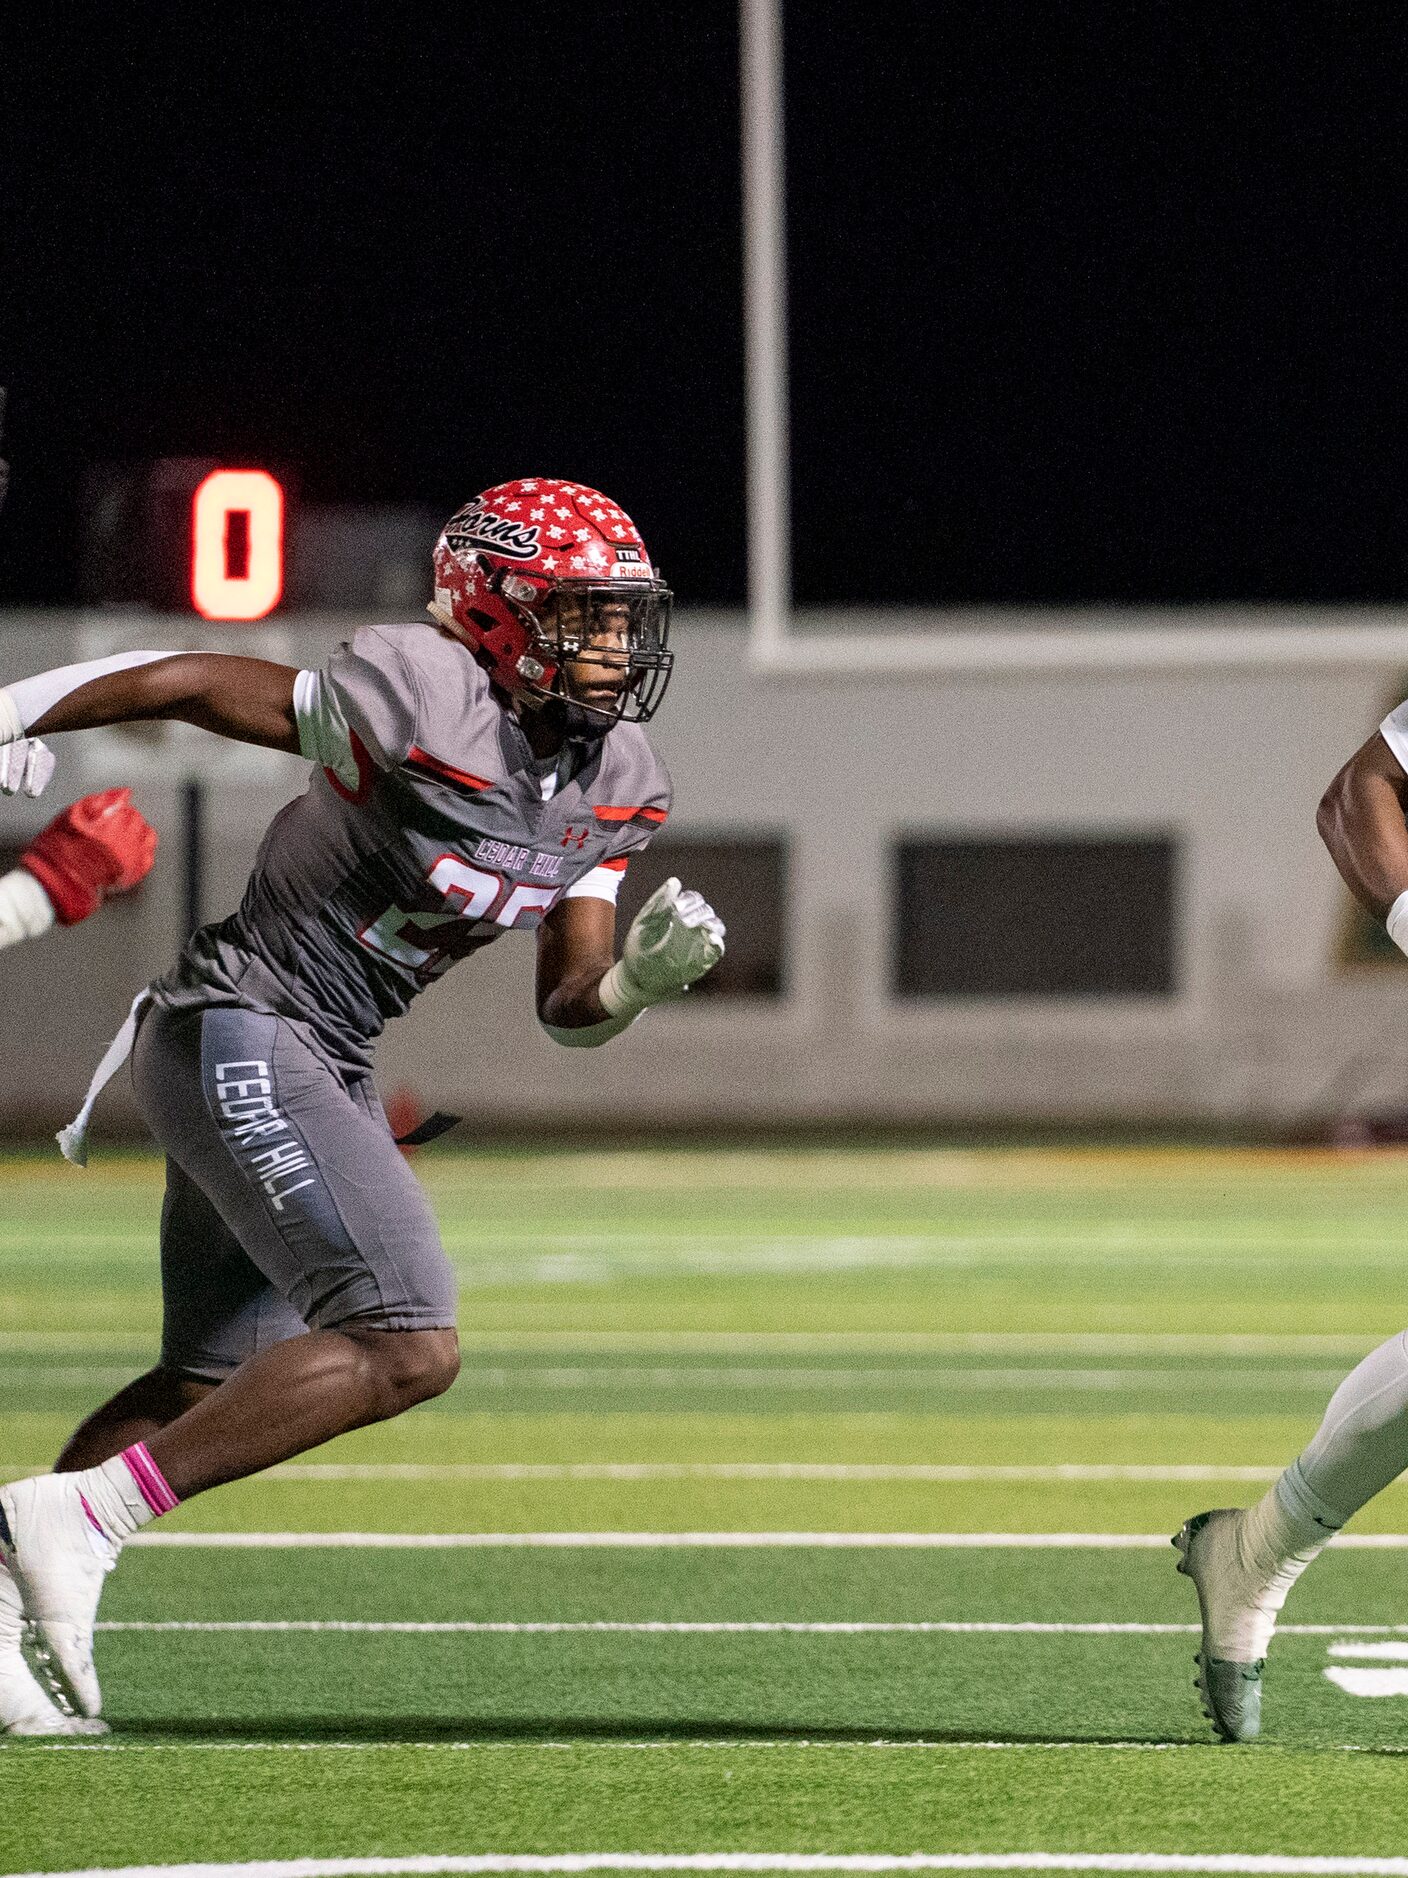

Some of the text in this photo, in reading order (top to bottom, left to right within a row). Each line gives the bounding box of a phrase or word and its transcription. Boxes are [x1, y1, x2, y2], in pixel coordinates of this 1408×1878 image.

[191, 467, 284, 622] 0
[475, 839, 530, 871] CEDAR
[215, 1060, 316, 1211] CEDAR HILL
